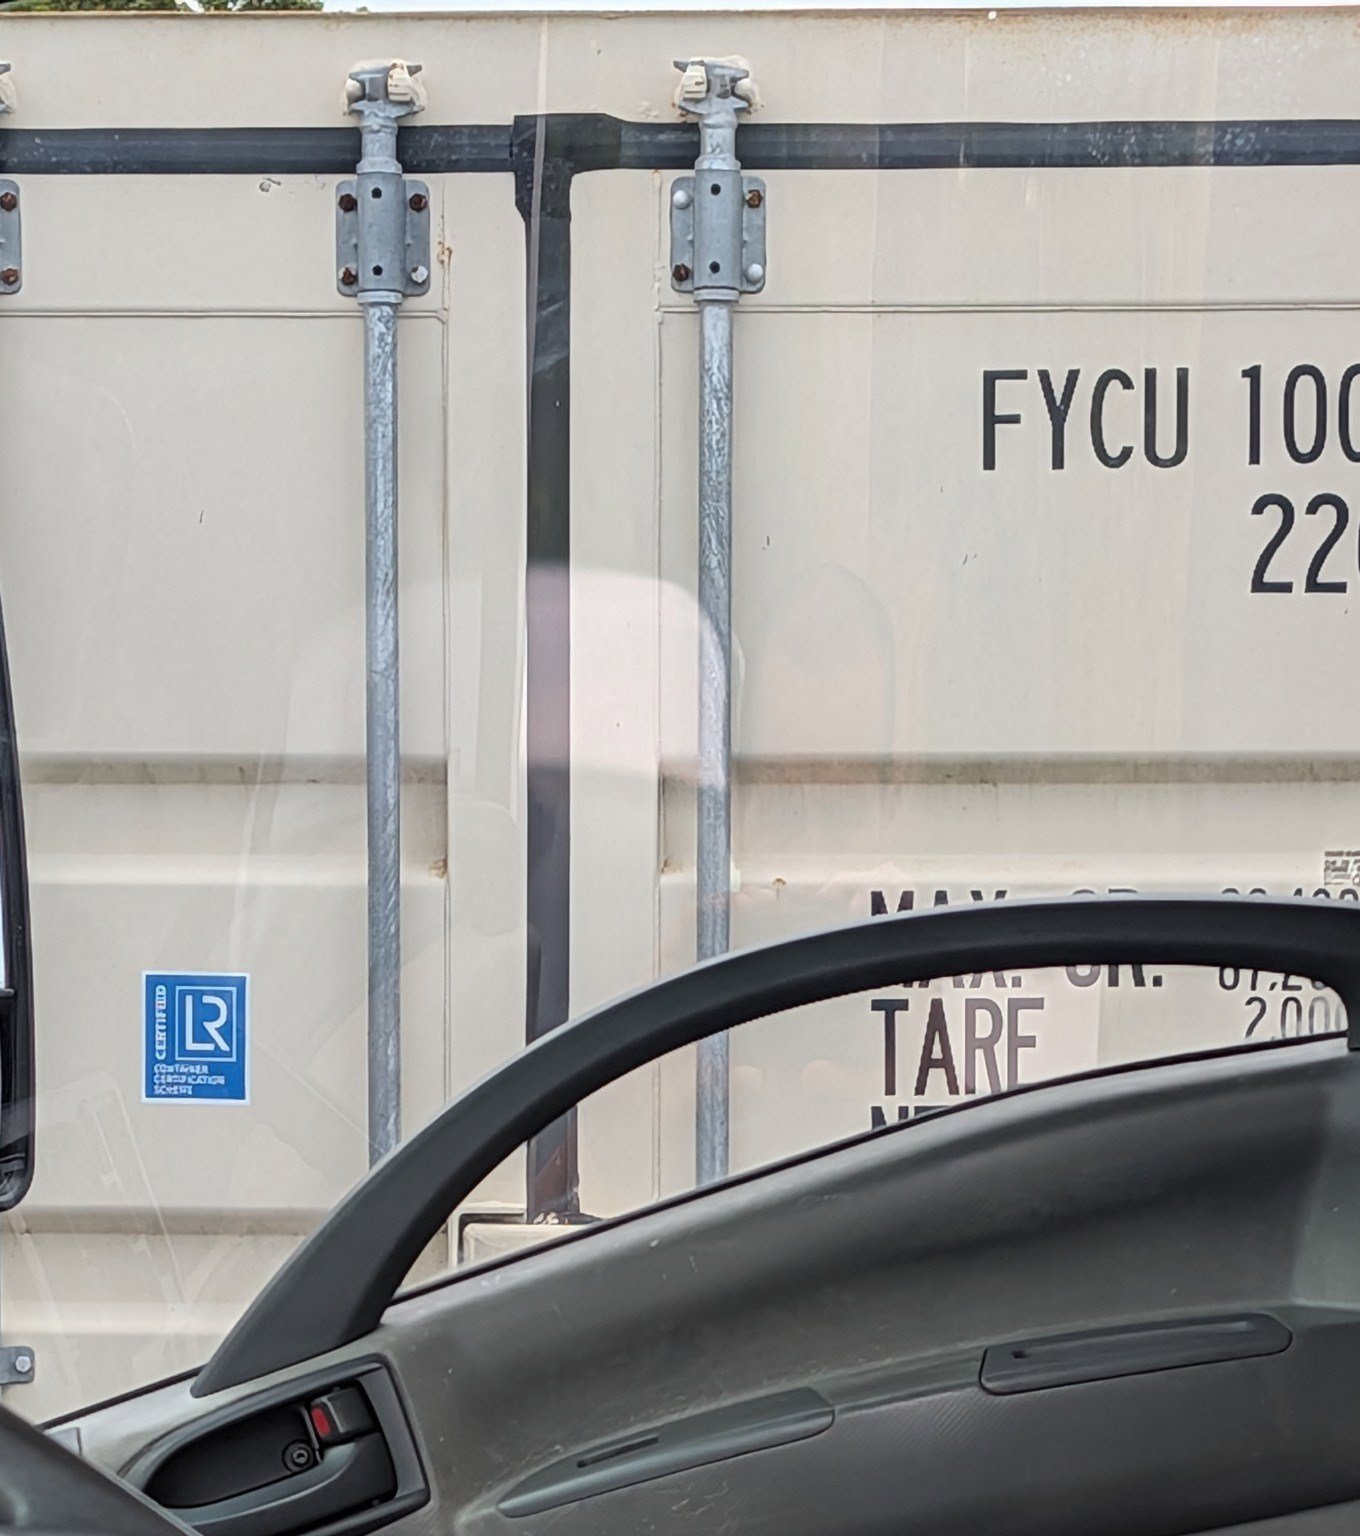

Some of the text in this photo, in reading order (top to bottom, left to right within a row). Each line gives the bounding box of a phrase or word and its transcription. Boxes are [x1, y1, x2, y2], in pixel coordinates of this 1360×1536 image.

[982, 366, 1190, 470] FYCU
[155, 985, 166, 1060] CERTIFIED
[185, 995, 230, 1051] LR
[1244, 996, 1349, 1039] 200
